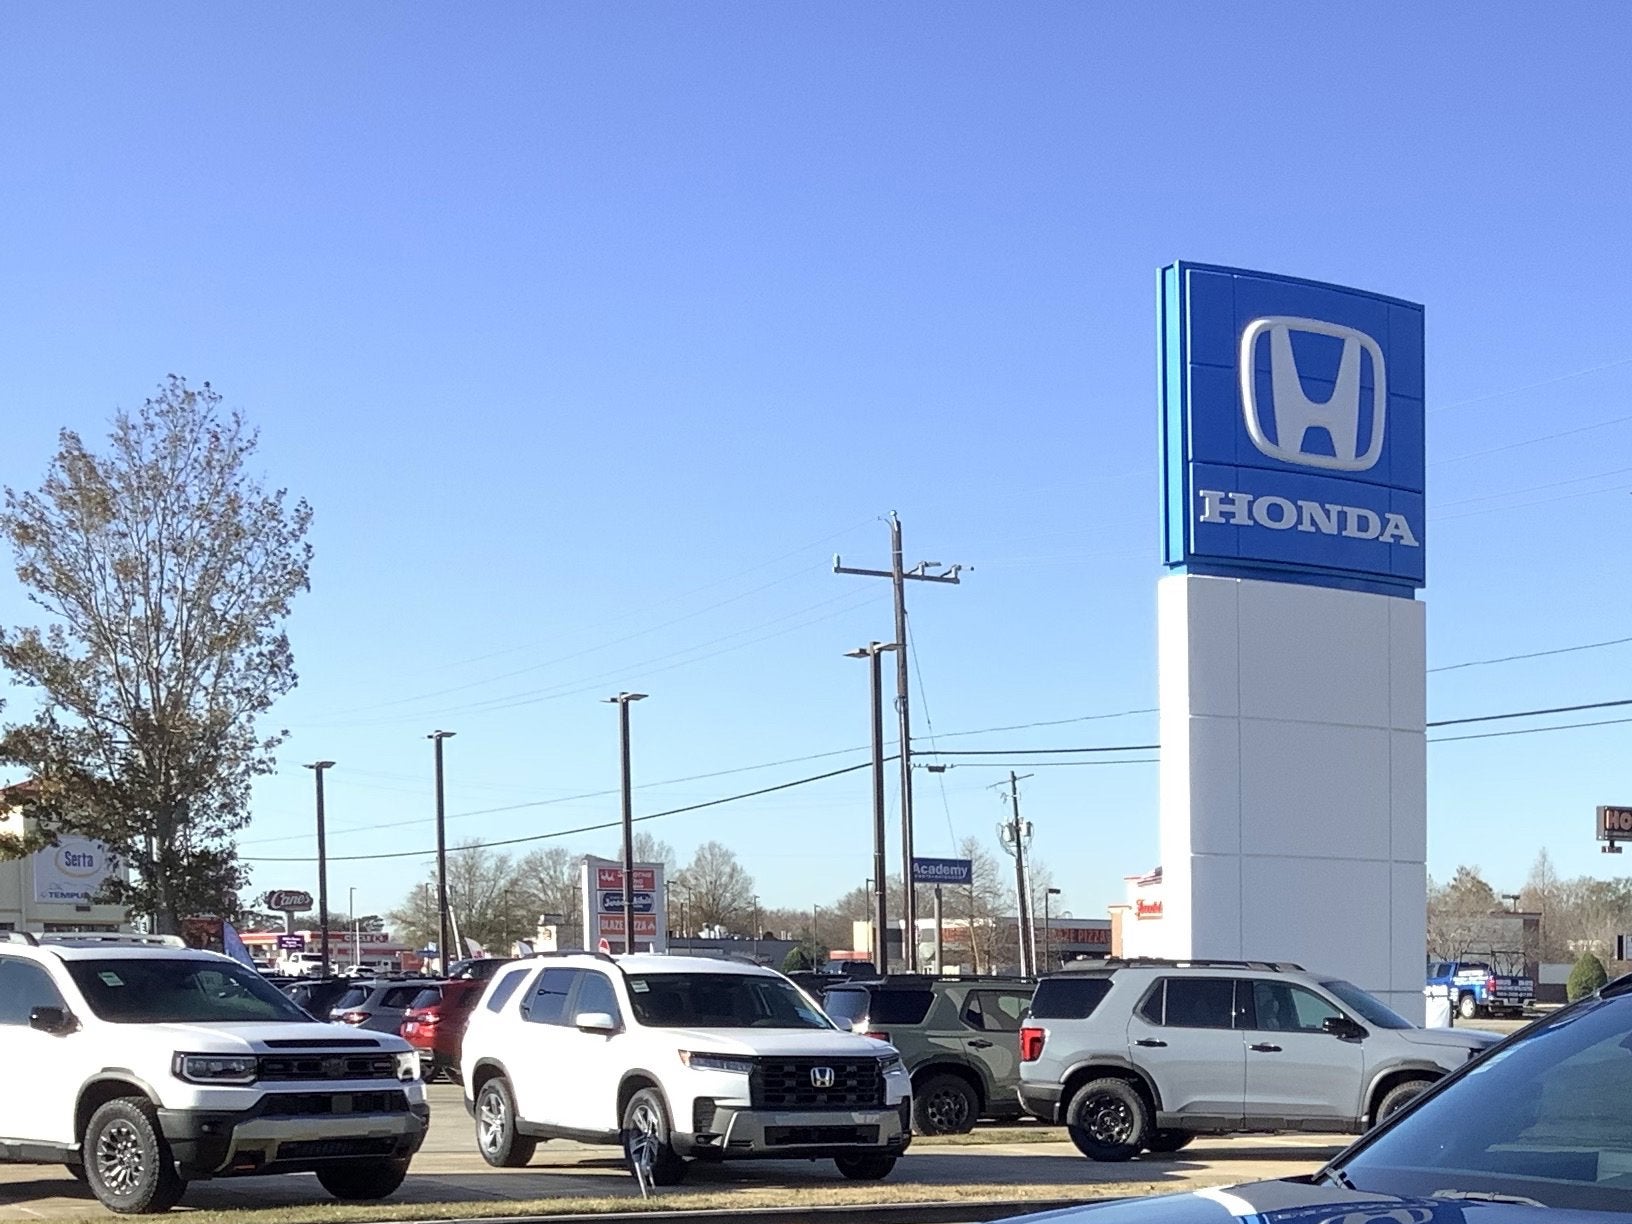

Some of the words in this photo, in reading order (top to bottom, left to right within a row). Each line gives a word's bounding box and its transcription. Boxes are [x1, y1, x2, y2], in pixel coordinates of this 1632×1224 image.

[1200, 490, 1420, 547] HONDA
[64, 851, 94, 868] Serta
[913, 862, 968, 878] Academy
